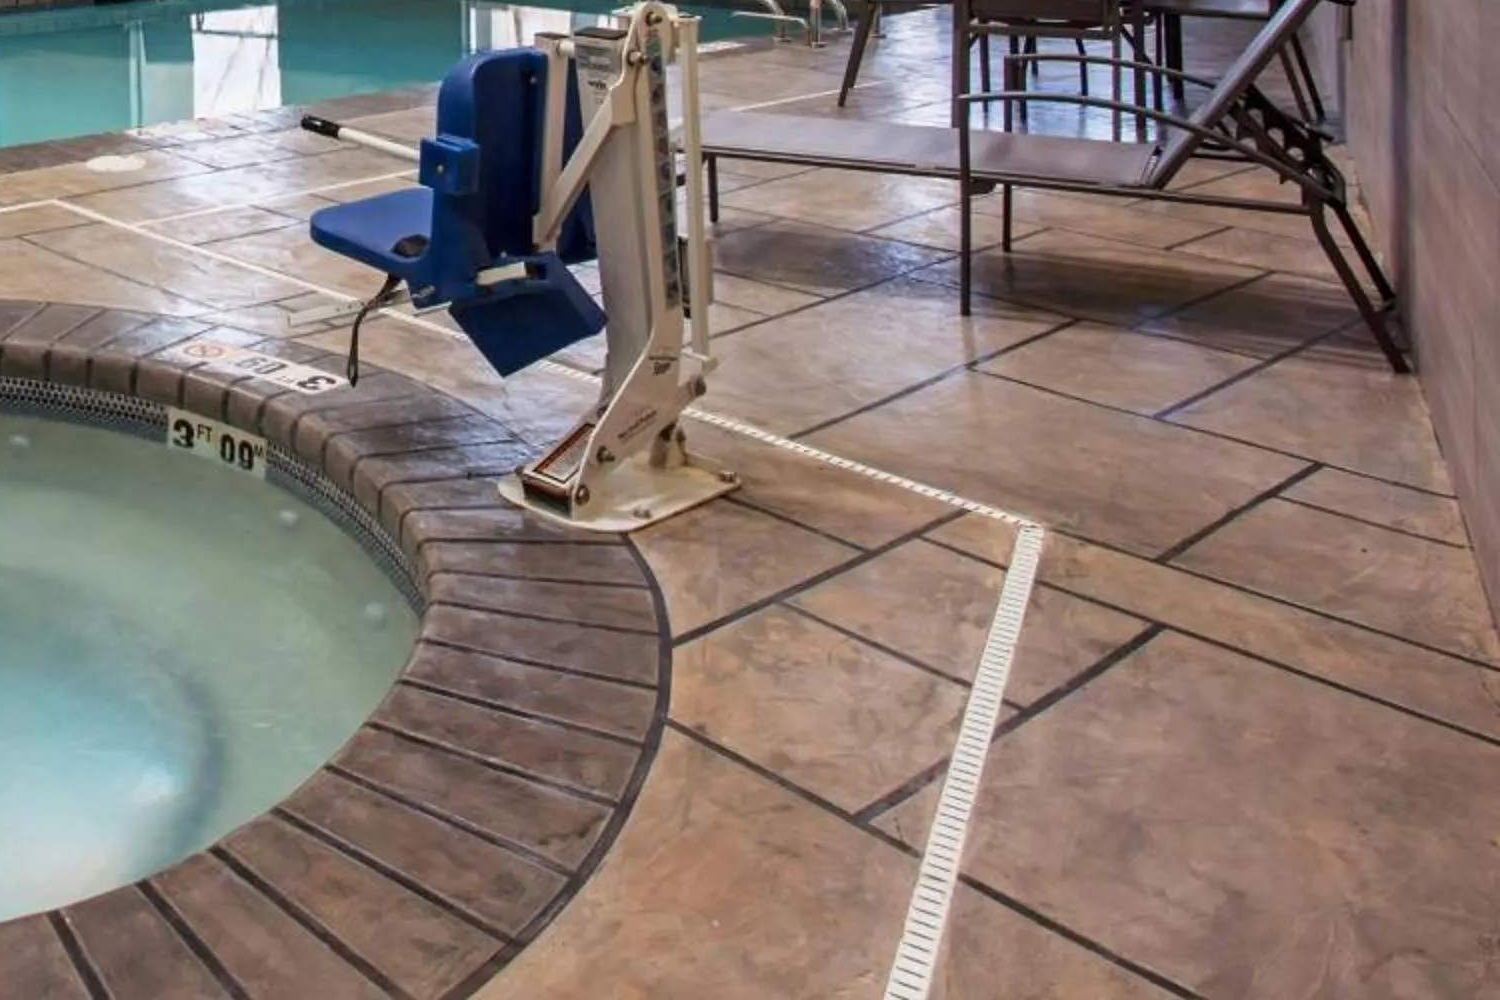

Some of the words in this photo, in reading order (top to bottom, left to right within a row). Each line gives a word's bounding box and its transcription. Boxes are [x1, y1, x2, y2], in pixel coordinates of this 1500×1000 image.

[297, 375, 337, 391] 3
[173, 418, 195, 450] 3
[197, 423, 213, 443] FT
